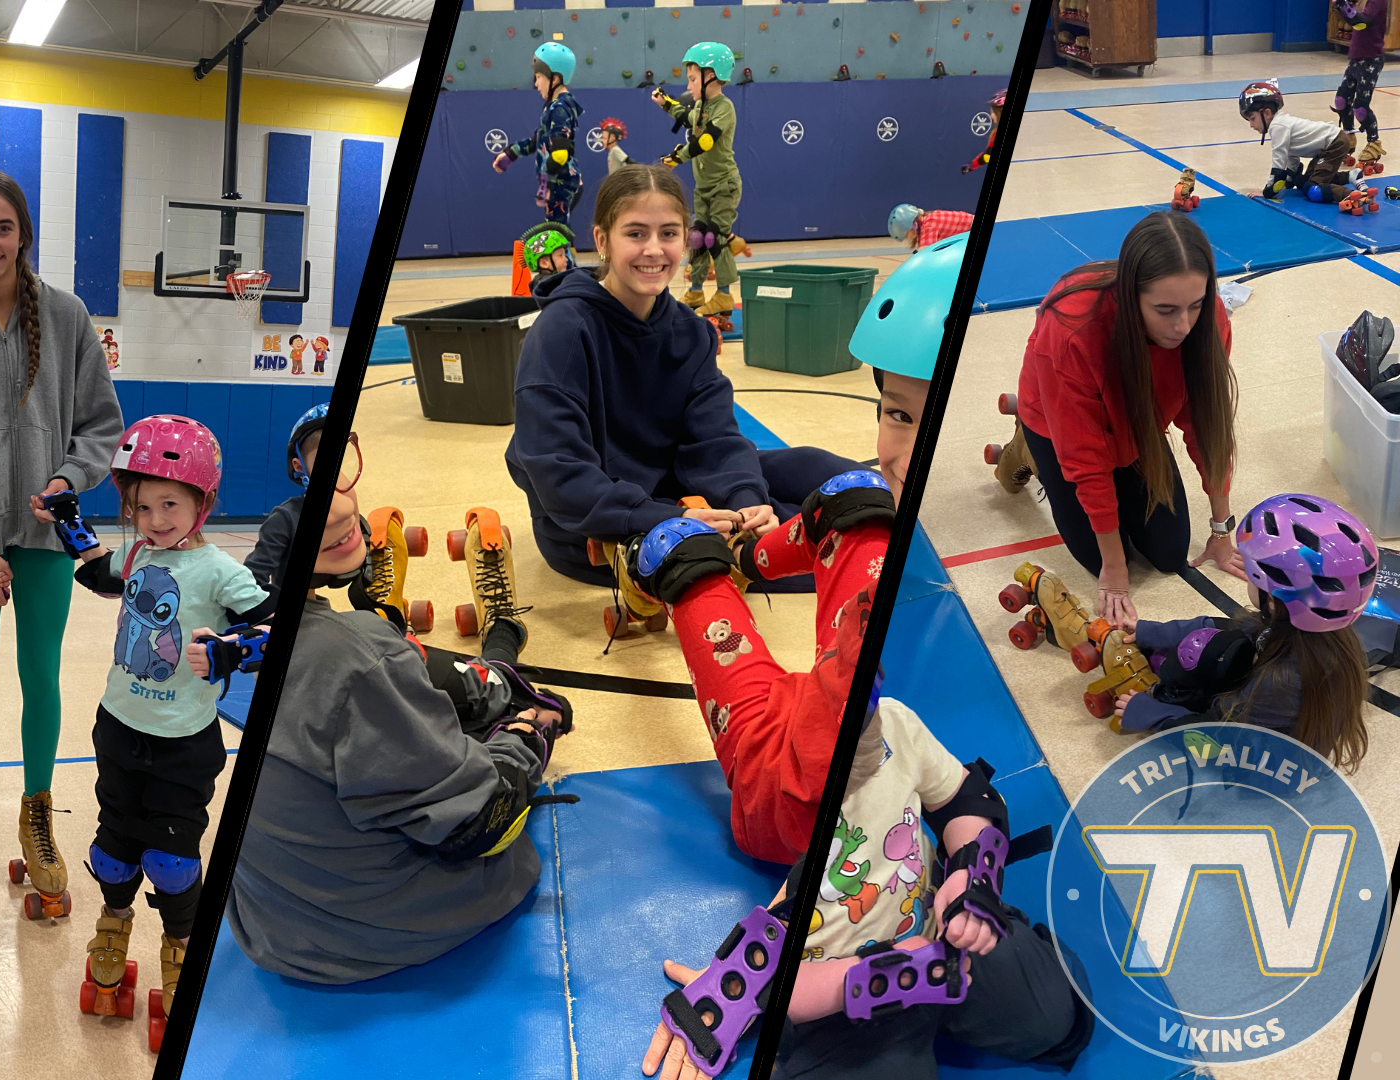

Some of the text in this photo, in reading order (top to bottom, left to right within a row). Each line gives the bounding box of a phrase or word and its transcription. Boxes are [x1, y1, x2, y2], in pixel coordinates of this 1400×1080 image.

[262, 334, 281, 352] BE
[254, 353, 288, 371] KIND
[129, 681, 176, 701] STITCH
